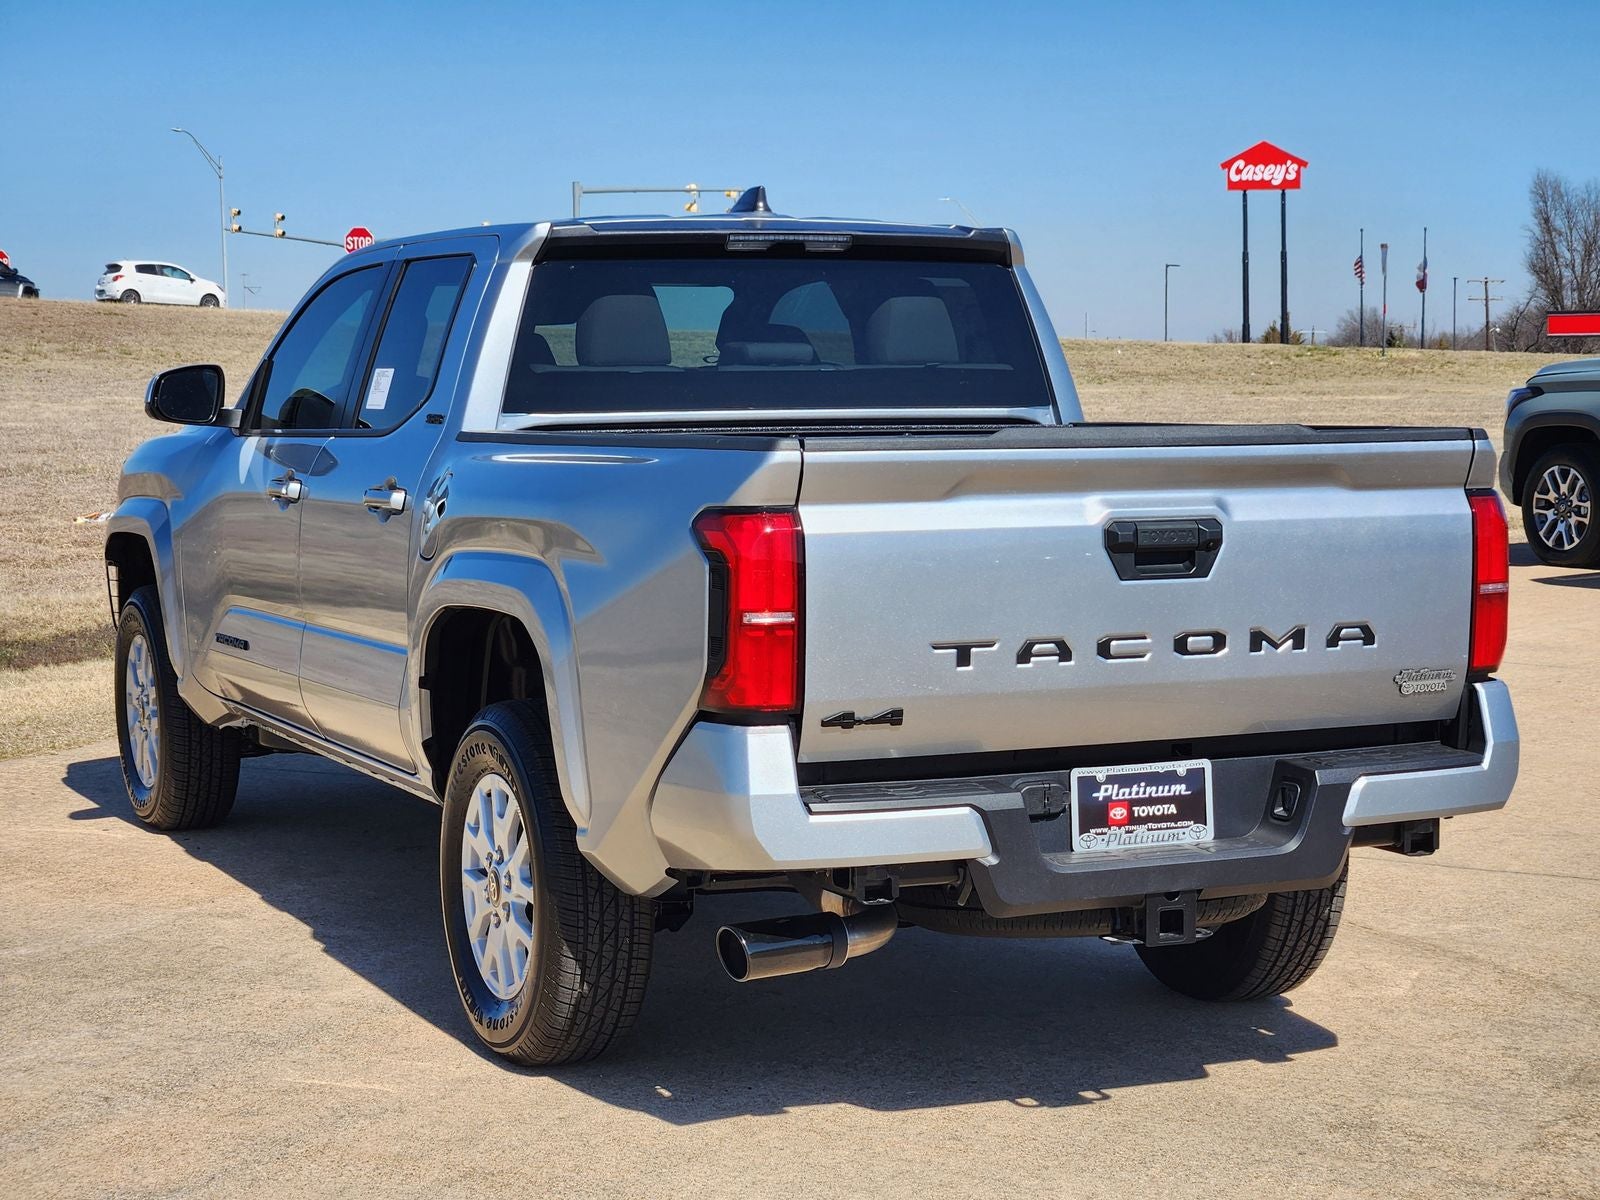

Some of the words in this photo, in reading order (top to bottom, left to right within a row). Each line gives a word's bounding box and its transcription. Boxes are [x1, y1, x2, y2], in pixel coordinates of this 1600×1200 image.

[1229, 159, 1299, 186] Casey's
[346, 236, 372, 250] STOP
[1140, 530, 1196, 542] TOYOTA
[930, 620, 1377, 671] TACOMA
[1415, 681, 1447, 693] TOYOTA
[1077, 761, 1204, 775] www.PlatinumToyota.com
[1092, 781, 1192, 801] Platinum
[1132, 804, 1177, 818] TOYOTA
[1106, 830, 1186, 848] Platinum
